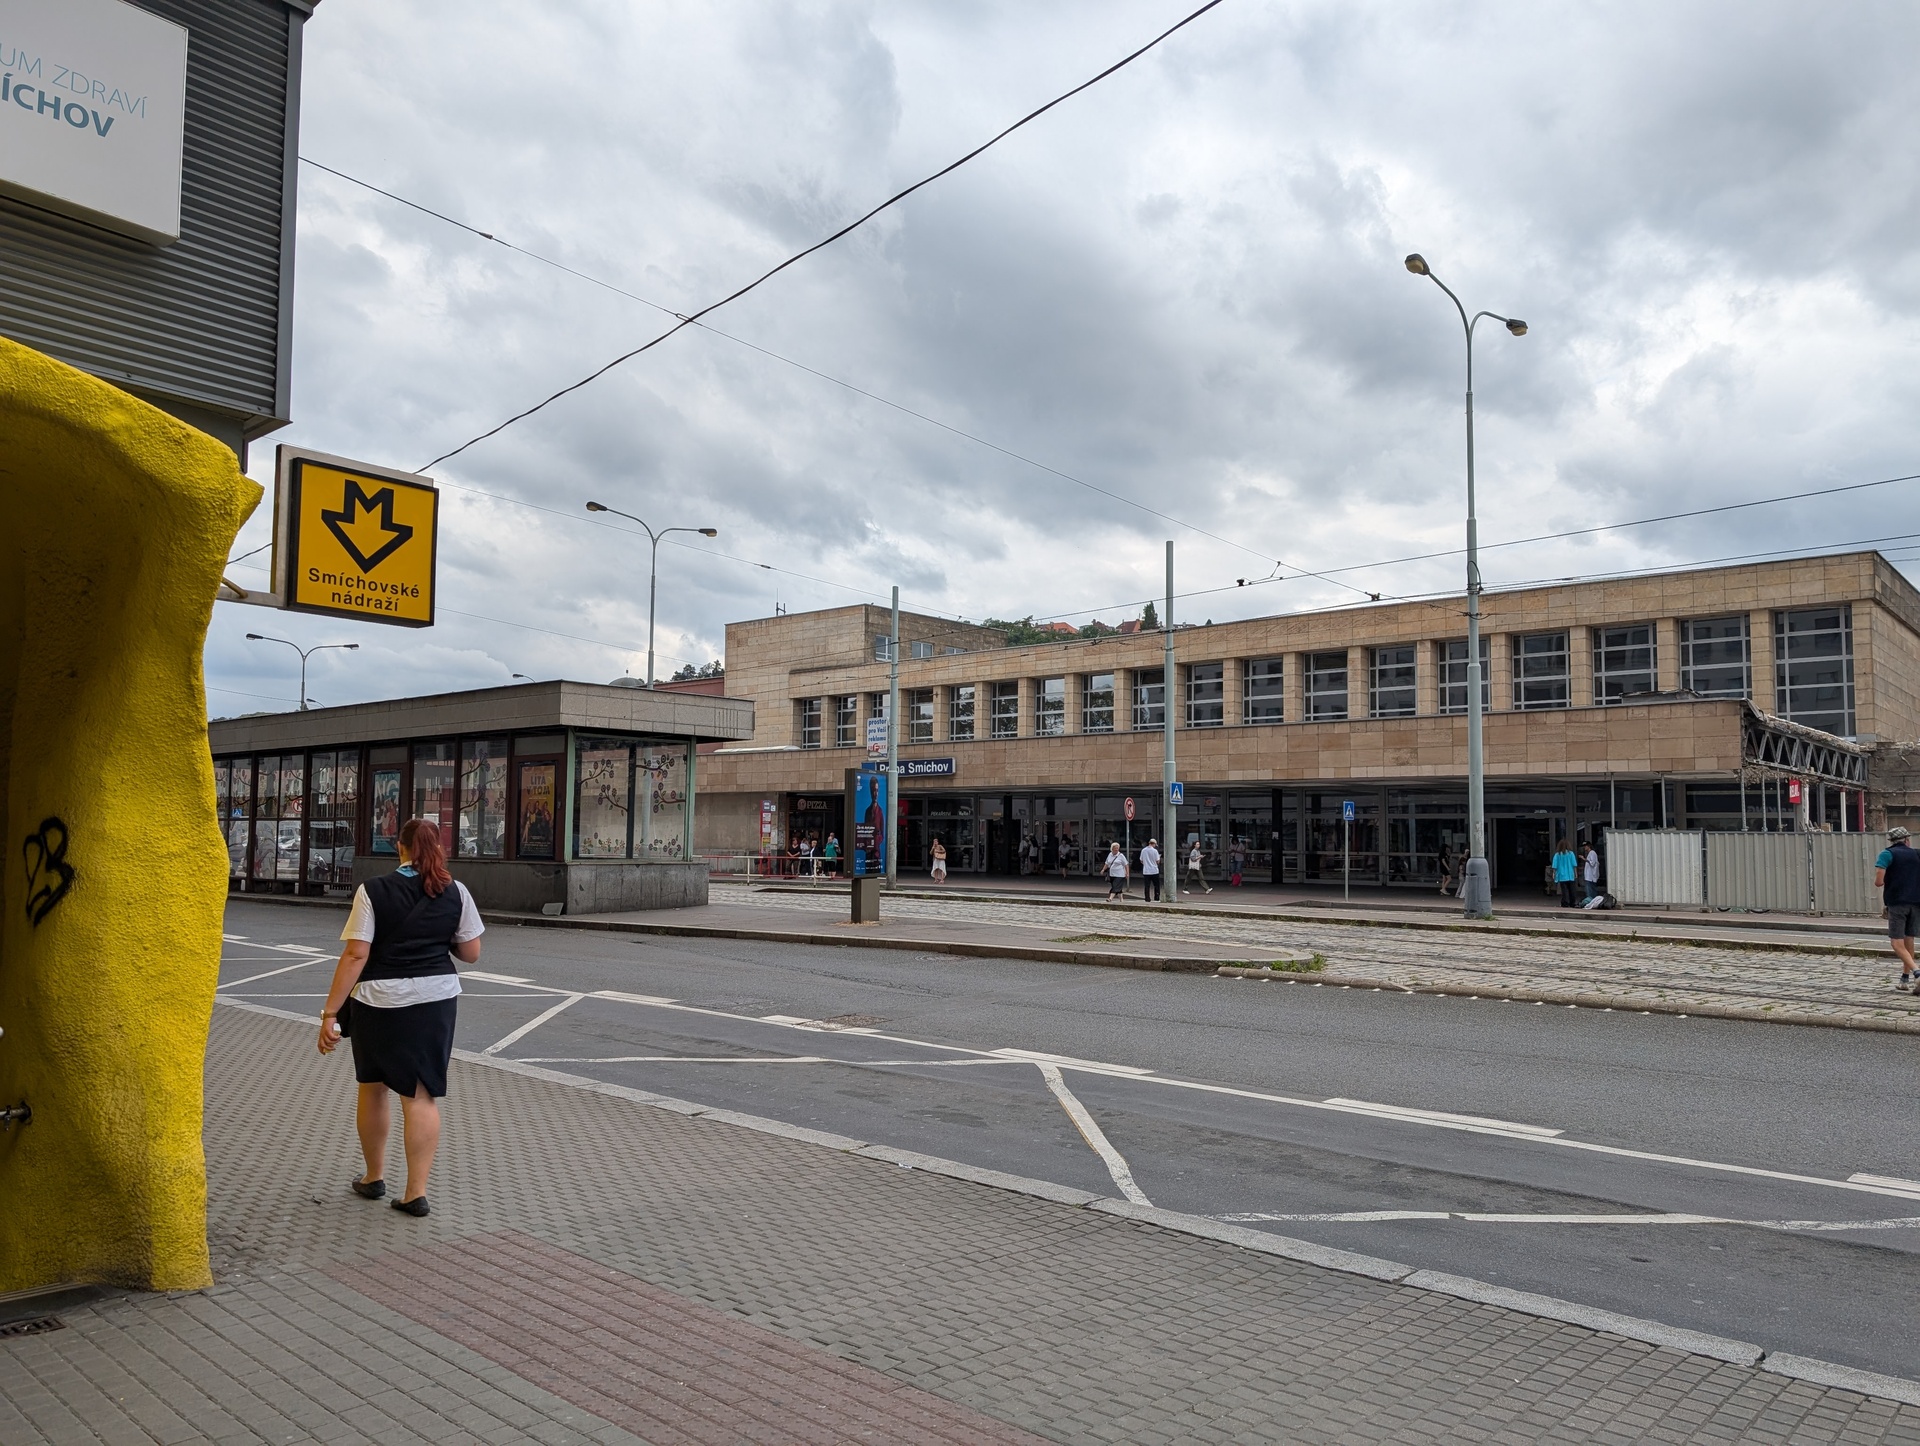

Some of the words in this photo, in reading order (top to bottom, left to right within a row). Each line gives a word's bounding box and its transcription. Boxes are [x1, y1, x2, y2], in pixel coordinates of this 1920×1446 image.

[52, 64, 148, 119] ZDRAVÍ
[1, 72, 115, 138] ÍCHOV
[308, 567, 420, 598] Smíchovské
[331, 591, 400, 612] nádraží
[868, 718, 887, 727] prostor
[868, 728, 876, 736] pro
[908, 761, 949, 773] Smíchov
[807, 800, 828, 809] PIZZA
